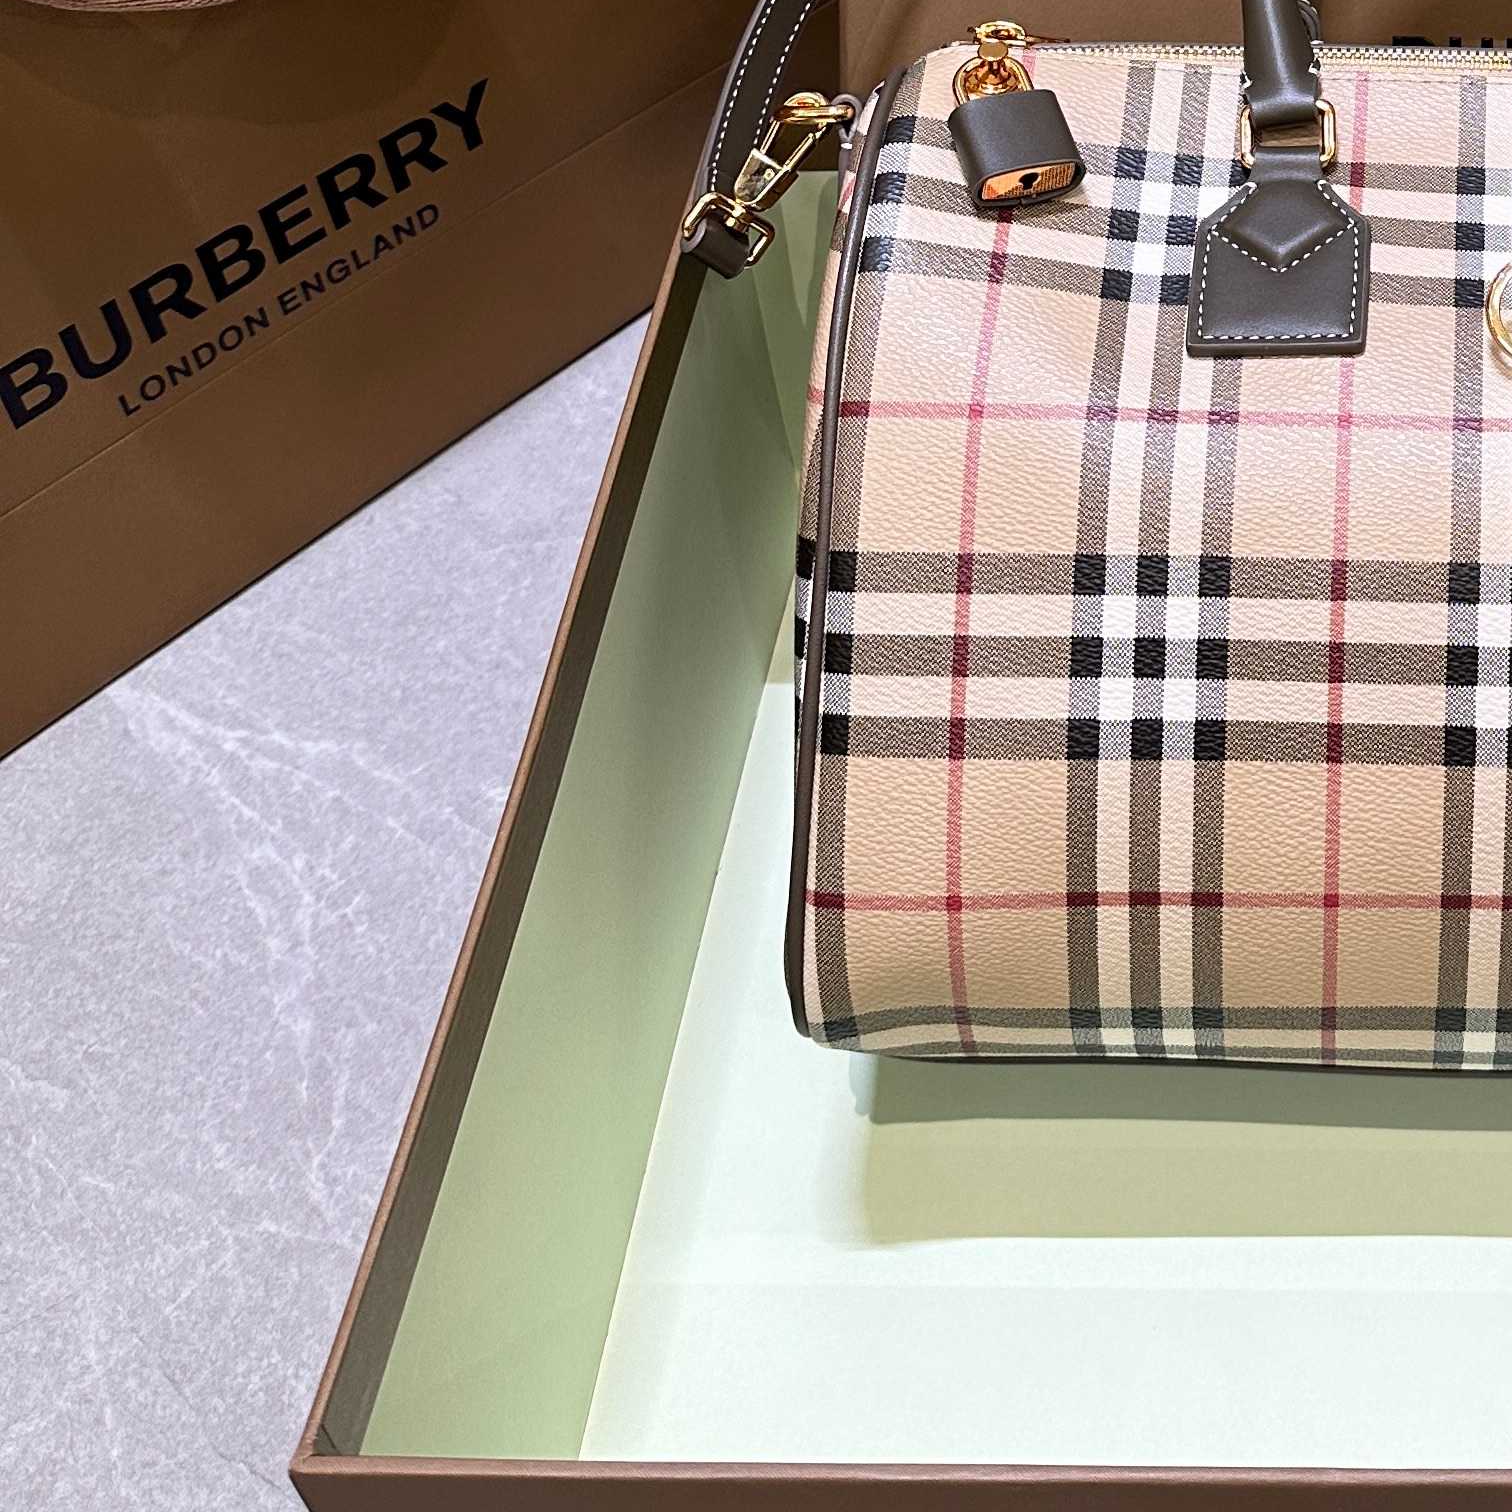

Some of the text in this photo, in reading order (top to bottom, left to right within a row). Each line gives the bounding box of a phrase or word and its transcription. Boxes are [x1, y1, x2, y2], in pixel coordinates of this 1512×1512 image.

[0, 78, 489, 430] BURBERRY
[117, 202, 440, 417] LONDON ENGLAND
